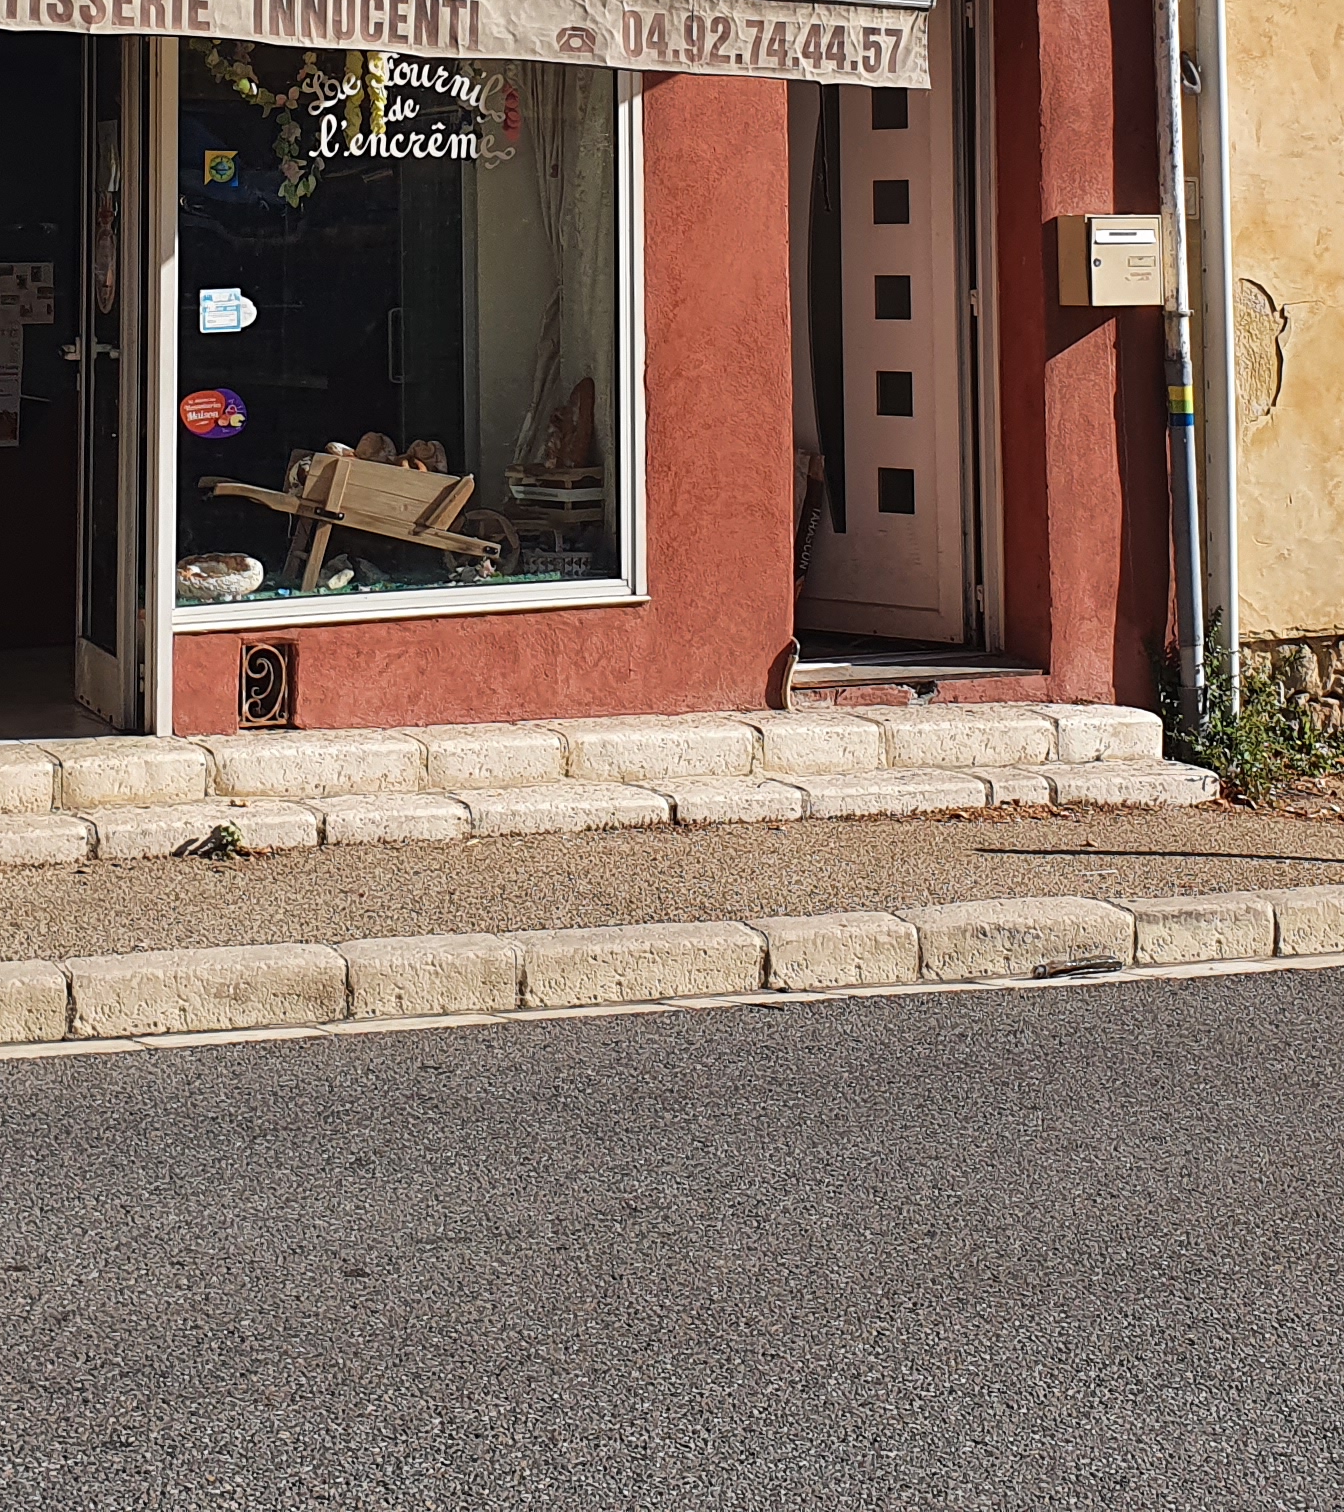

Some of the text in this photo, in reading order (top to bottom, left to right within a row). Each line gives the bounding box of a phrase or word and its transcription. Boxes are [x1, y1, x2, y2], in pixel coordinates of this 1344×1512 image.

[621, 9, 905, 75] 04.92.74.44.57
[368, 52, 506, 124] Fournil
[382, 95, 420, 123] de
